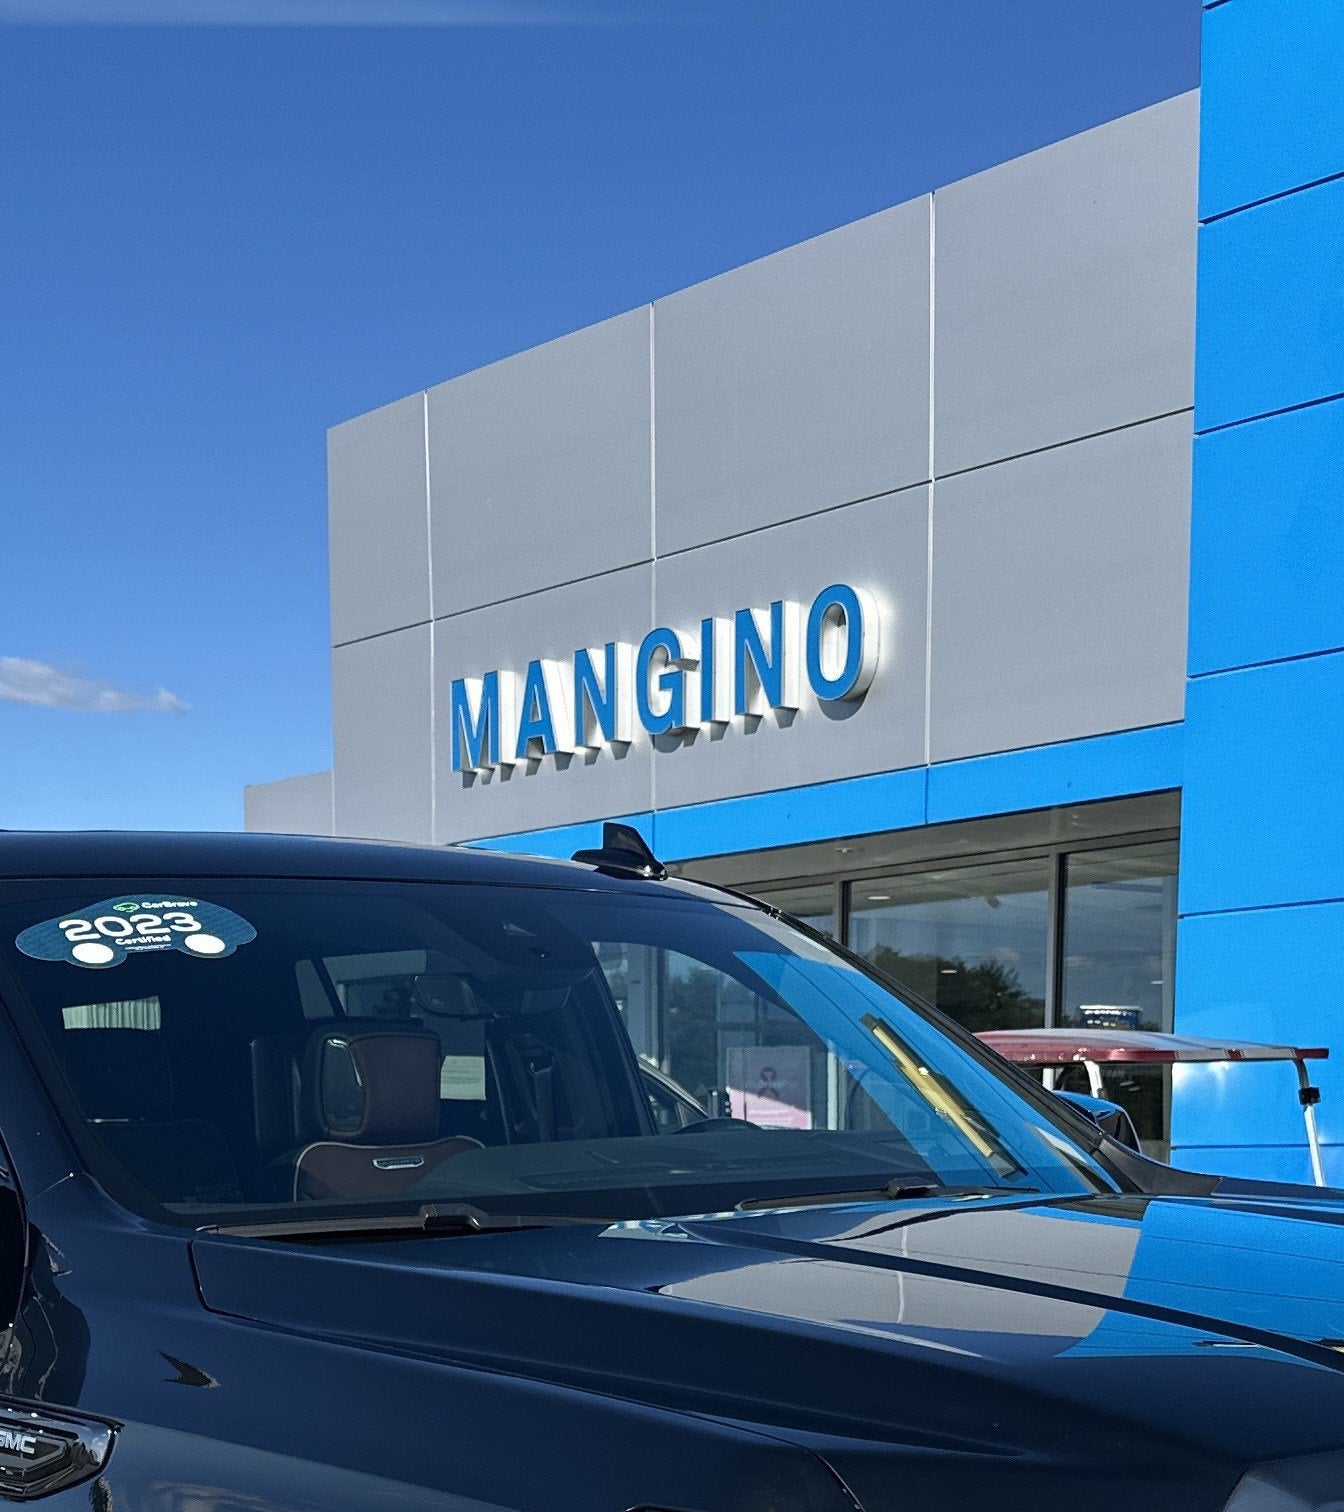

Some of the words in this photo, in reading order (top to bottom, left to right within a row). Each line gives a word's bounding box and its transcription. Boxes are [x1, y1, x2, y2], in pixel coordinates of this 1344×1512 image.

[451, 584, 878, 772] MANGINO
[58, 911, 202, 942] 2023
[115, 934, 172, 946] Certified
